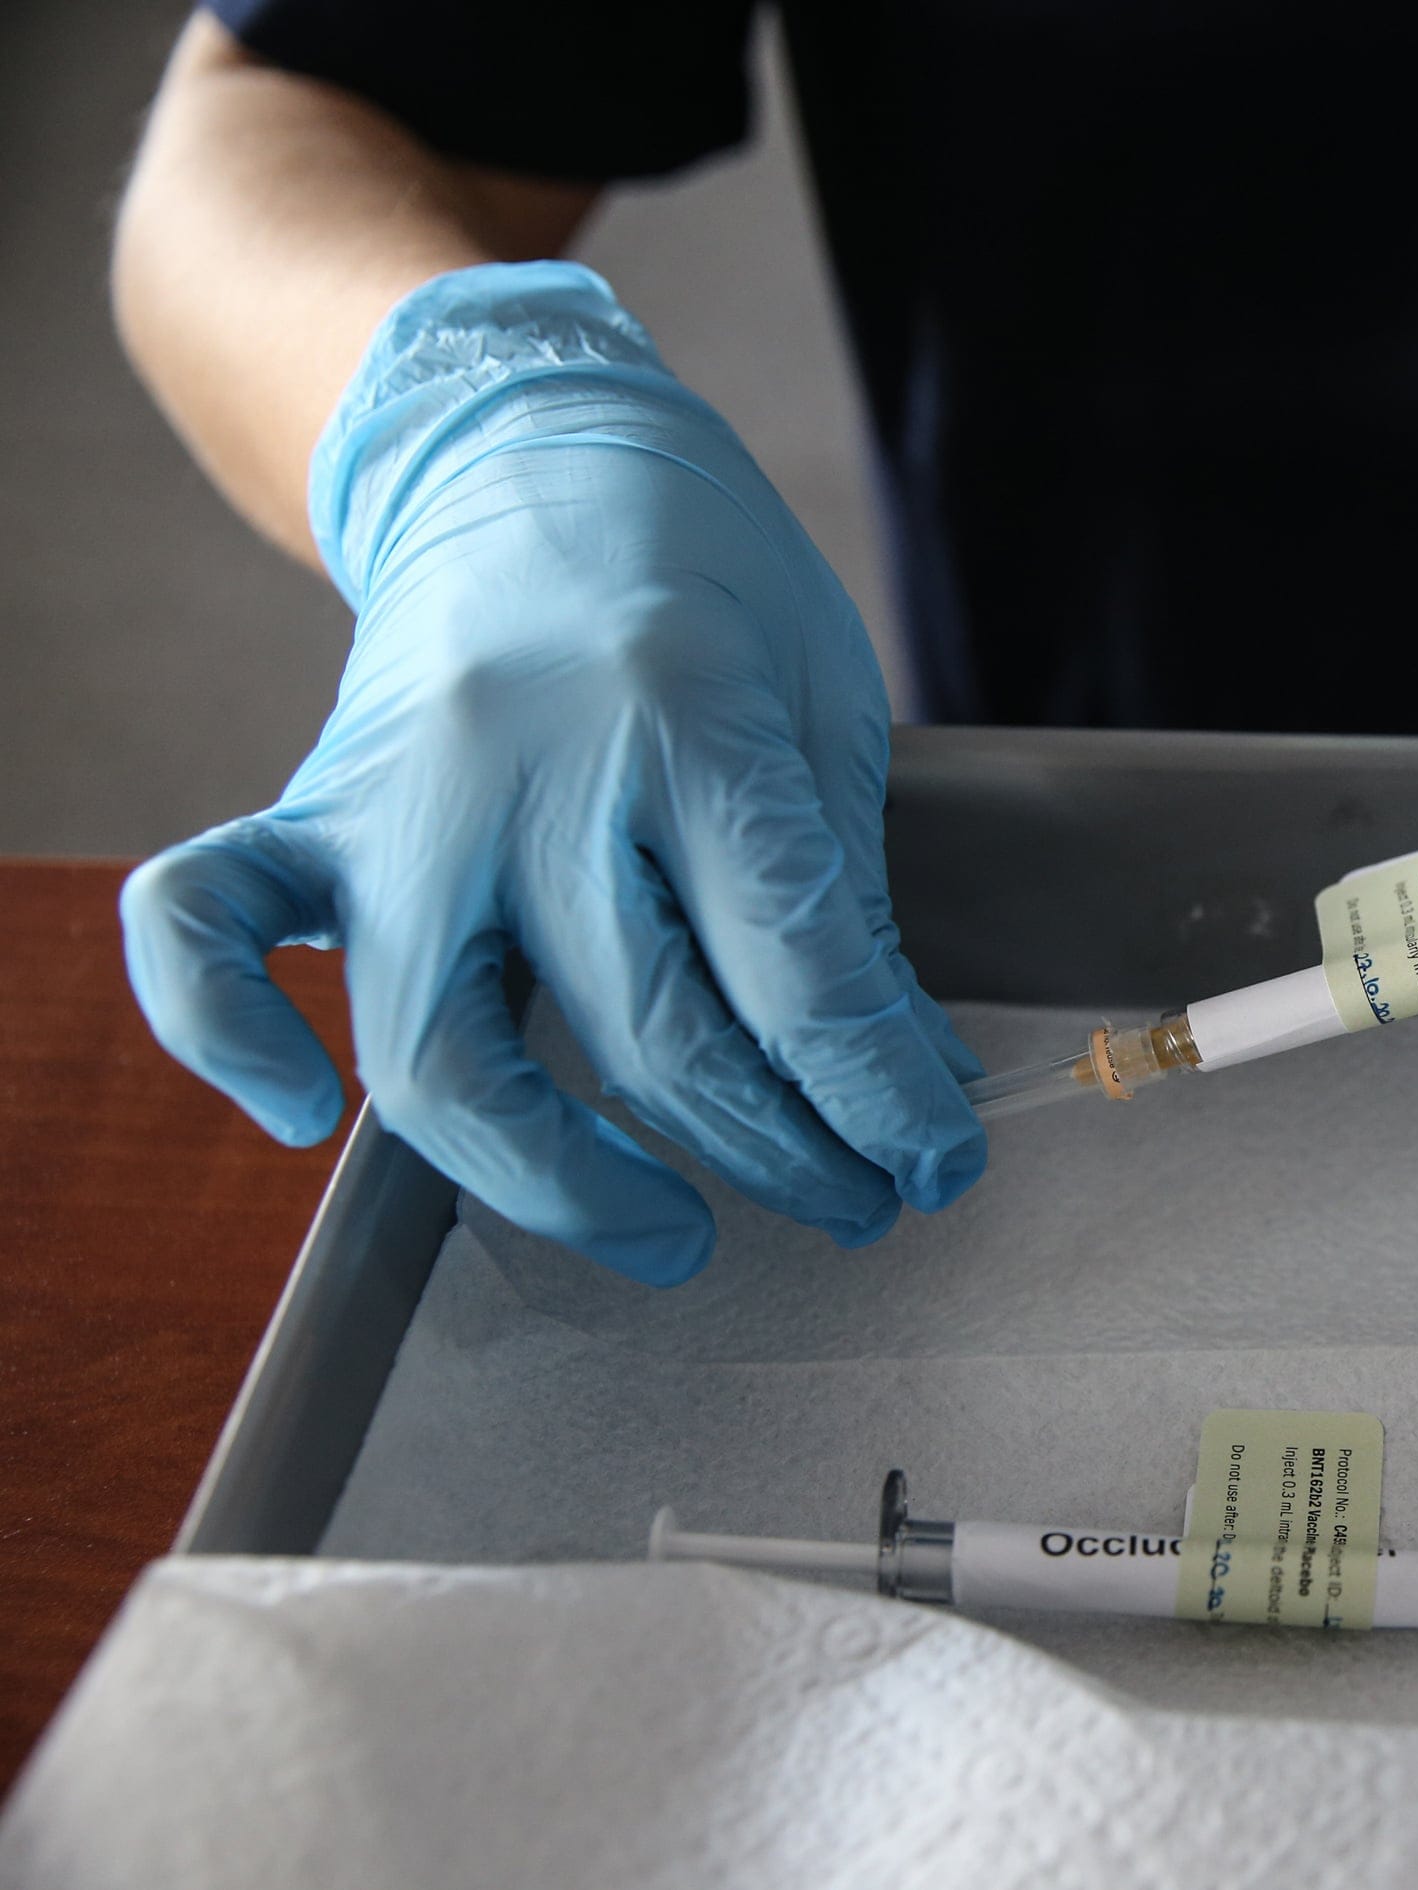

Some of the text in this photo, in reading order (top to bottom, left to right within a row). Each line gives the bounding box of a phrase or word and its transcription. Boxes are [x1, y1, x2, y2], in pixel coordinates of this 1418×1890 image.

[1231, 1444, 1245, 1461] Do
[1280, 1446, 1298, 1478] Inject
[1229, 1463, 1241, 1481] not
[1309, 1447, 1326, 1508] BNT162b2
[1336, 1448, 1352, 1494] Protocol
[1226, 1483, 1240, 1502] use
[1282, 1480, 1296, 1500] 0.3
[1224, 1504, 1239, 1531] after:
[1279, 1502, 1293, 1520] mL
[1334, 1498, 1349, 1518] No.:
